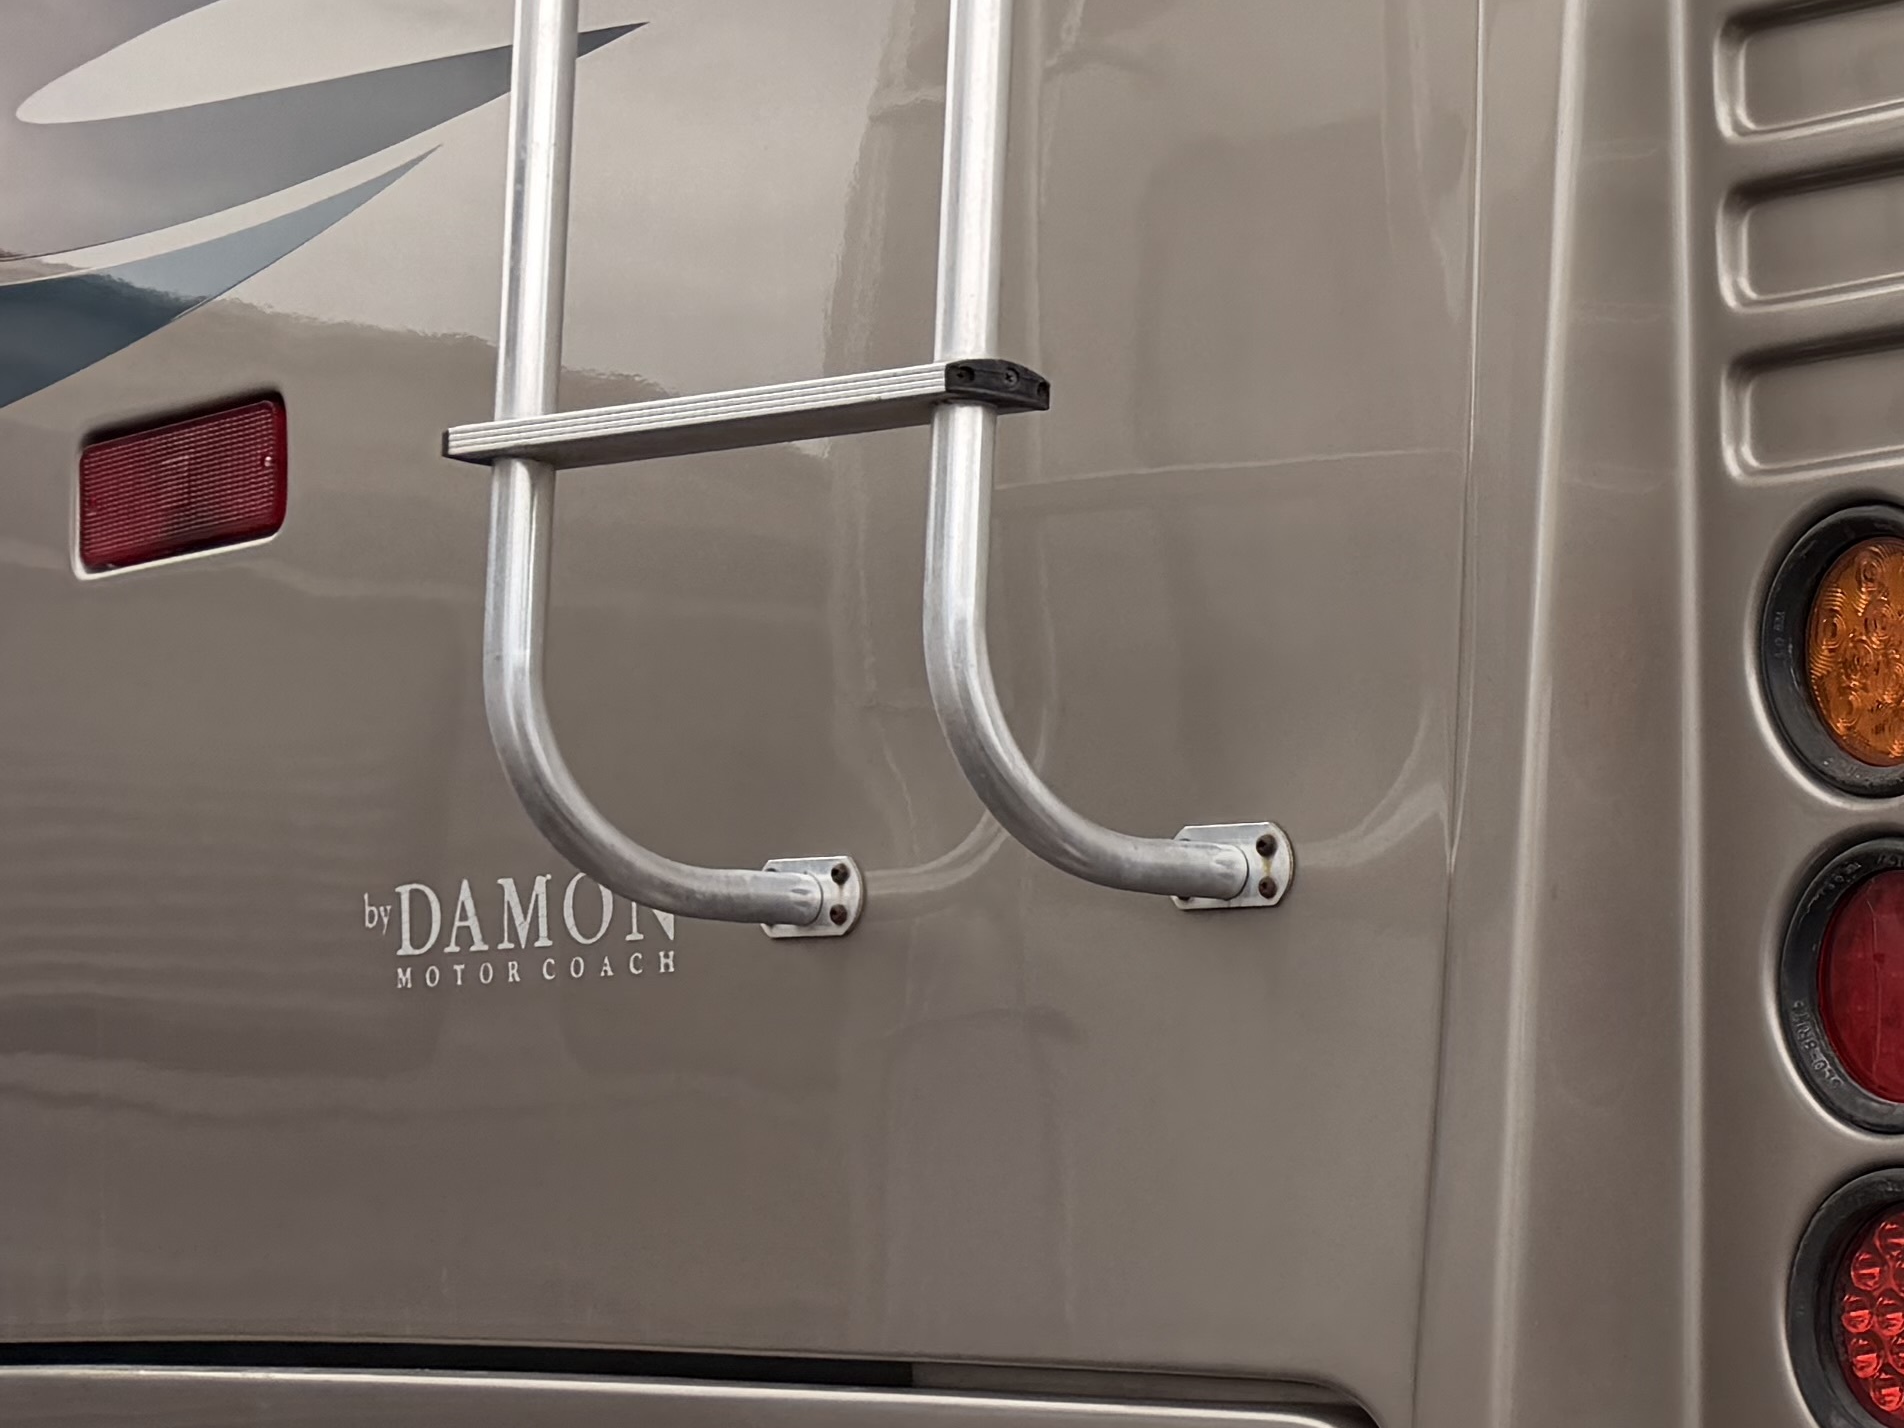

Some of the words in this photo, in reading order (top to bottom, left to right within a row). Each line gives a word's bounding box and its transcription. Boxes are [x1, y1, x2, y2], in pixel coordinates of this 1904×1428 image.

[364, 892, 392, 935] by
[396, 961, 521, 989] MOTOR
[541, 951, 675, 980] COACH
